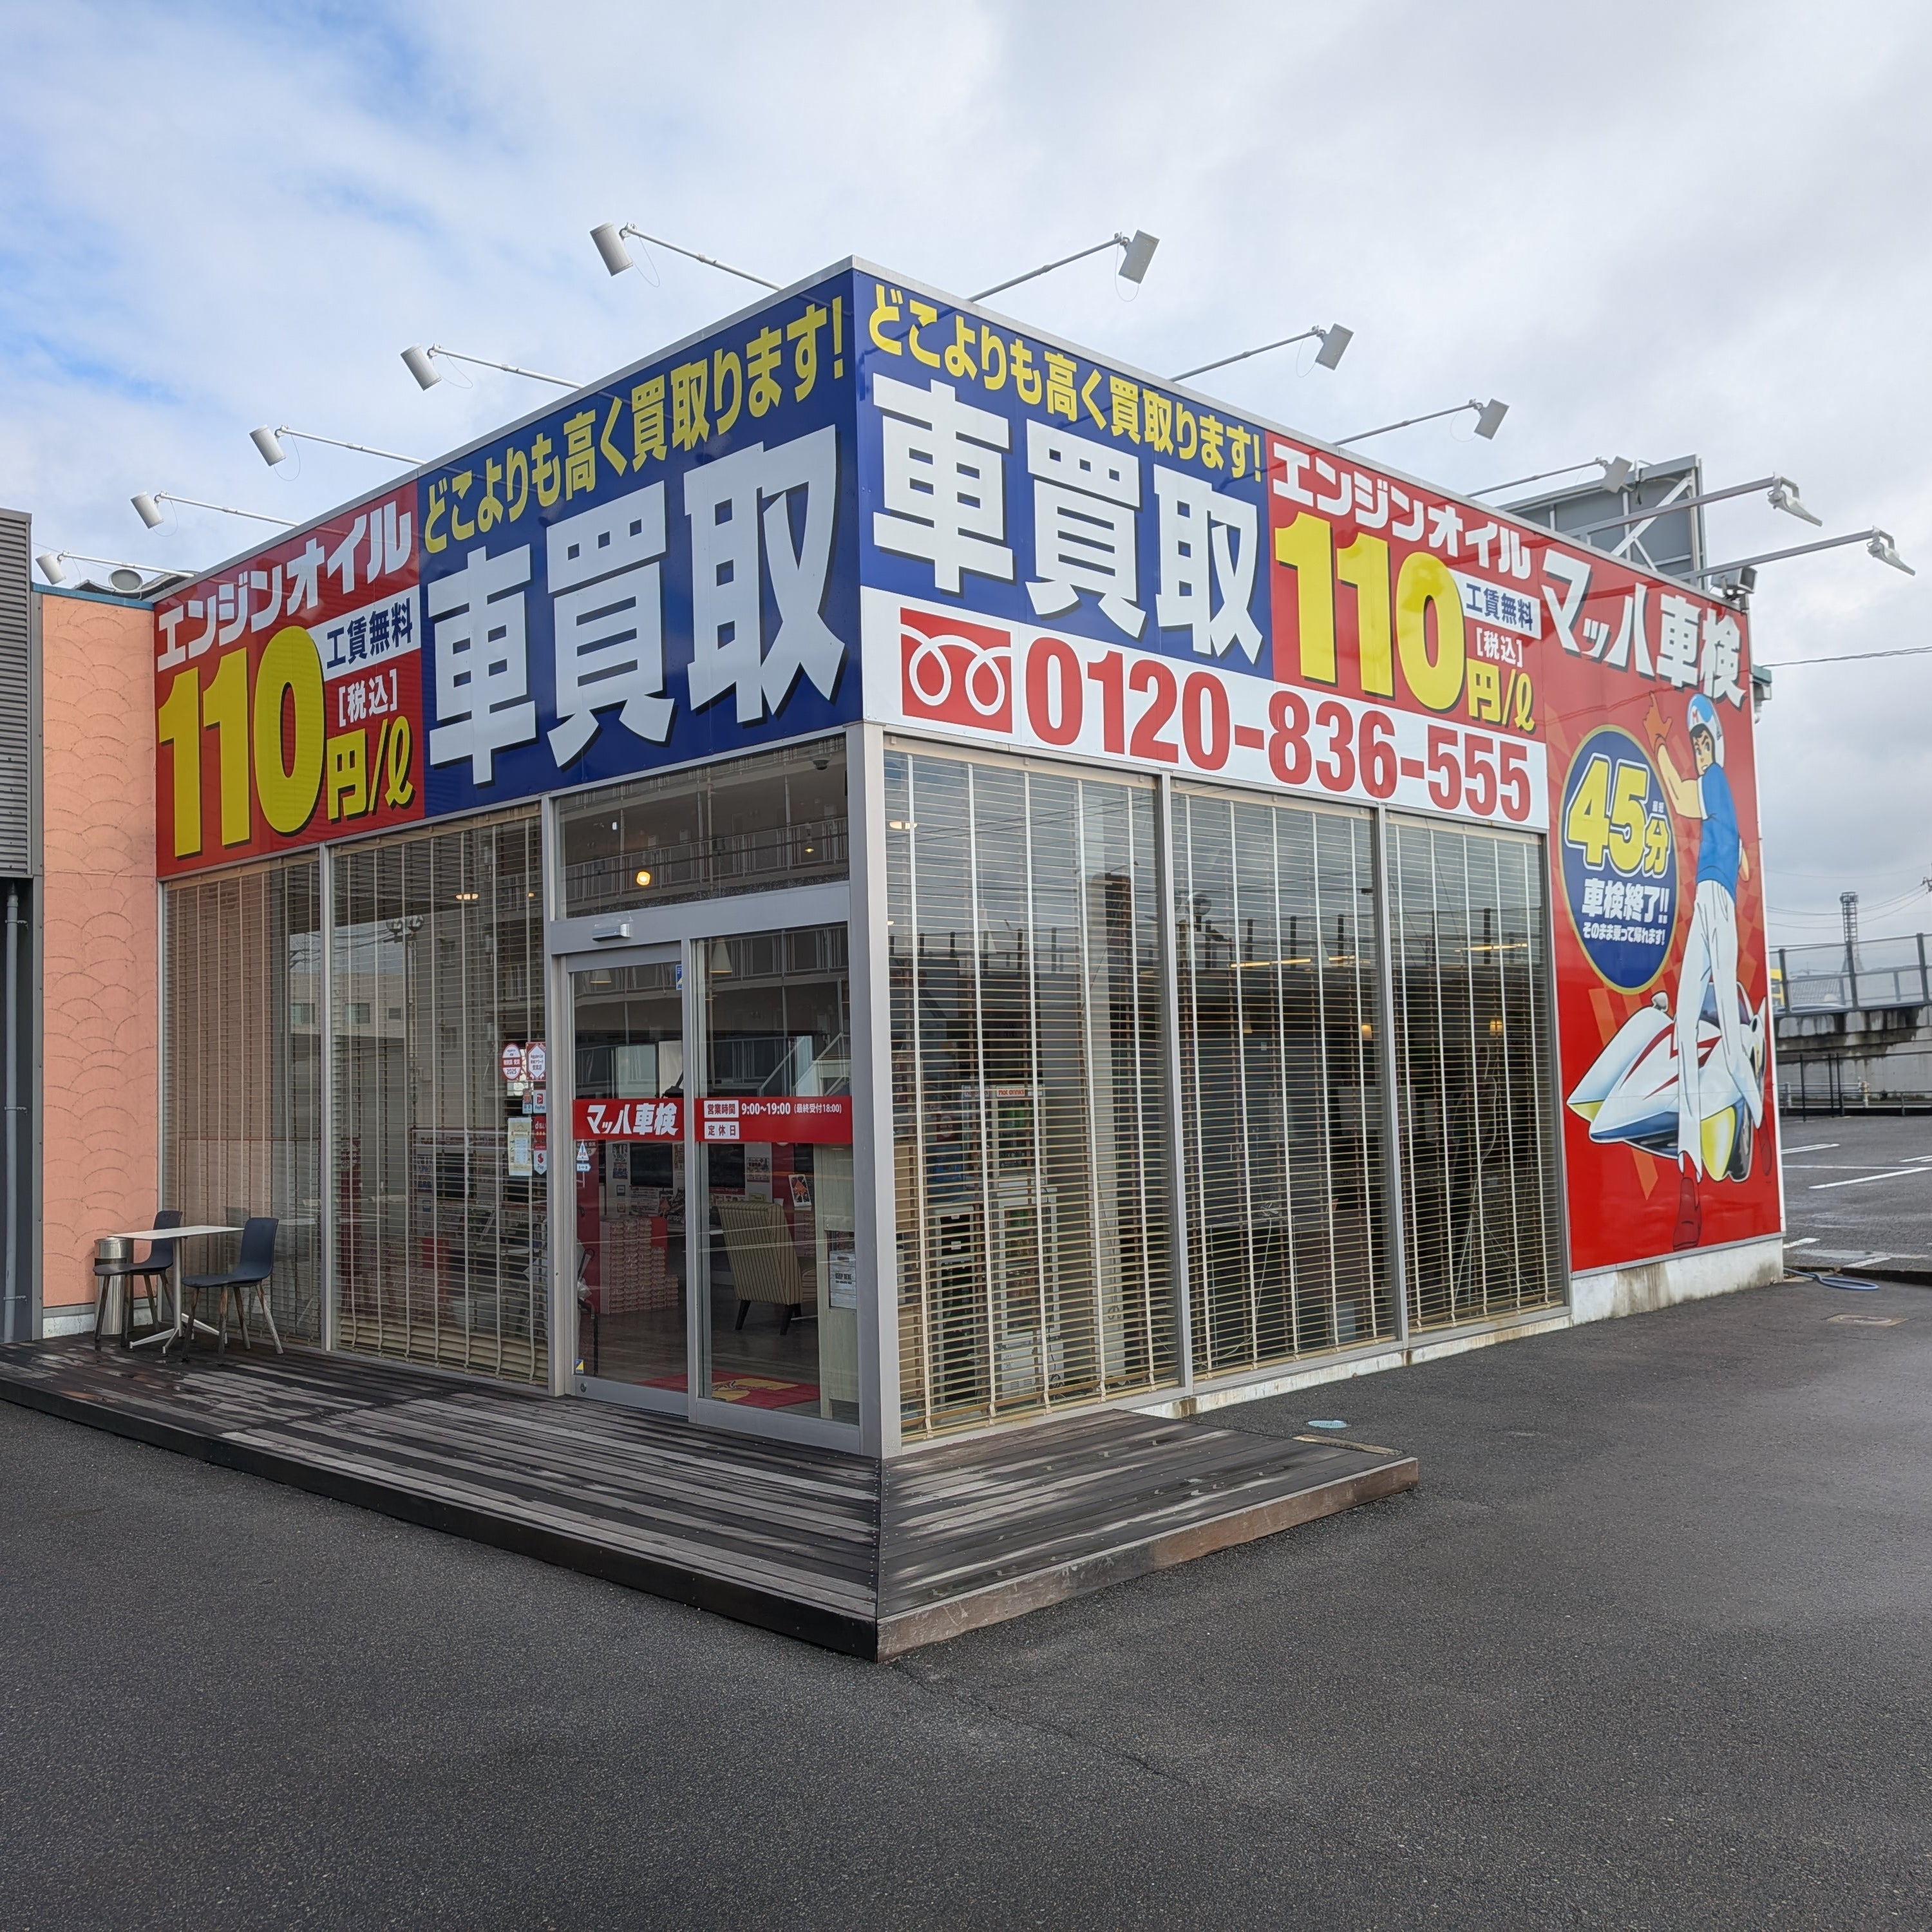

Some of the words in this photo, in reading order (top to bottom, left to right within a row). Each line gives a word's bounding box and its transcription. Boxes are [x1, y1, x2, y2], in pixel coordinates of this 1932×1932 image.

[424, 296, 844, 554] どこよりも高く買取ります!
[869, 283, 1262, 482] どこよりも高く買取ります!
[873, 373, 1263, 665] 車買取
[1273, 442, 1531, 580] エンジンオイル
[157, 501, 412, 672] エンジンオイル
[327, 597, 413, 670] 工賃無料
[428, 424, 846, 784] 車買取
[1466, 583, 1533, 630] 工賃無料
[1541, 548, 1746, 708] マッハ車検
[1027, 636, 1532, 822] 0120-836-555
[1582, 878, 1670, 924] 車検終了!!
[1582, 922, 1665, 945] そのまま乗って帰れます!
[587, 1103, 678, 1136] マッハ車検
[707, 1104, 735, 1115] 営業時間
